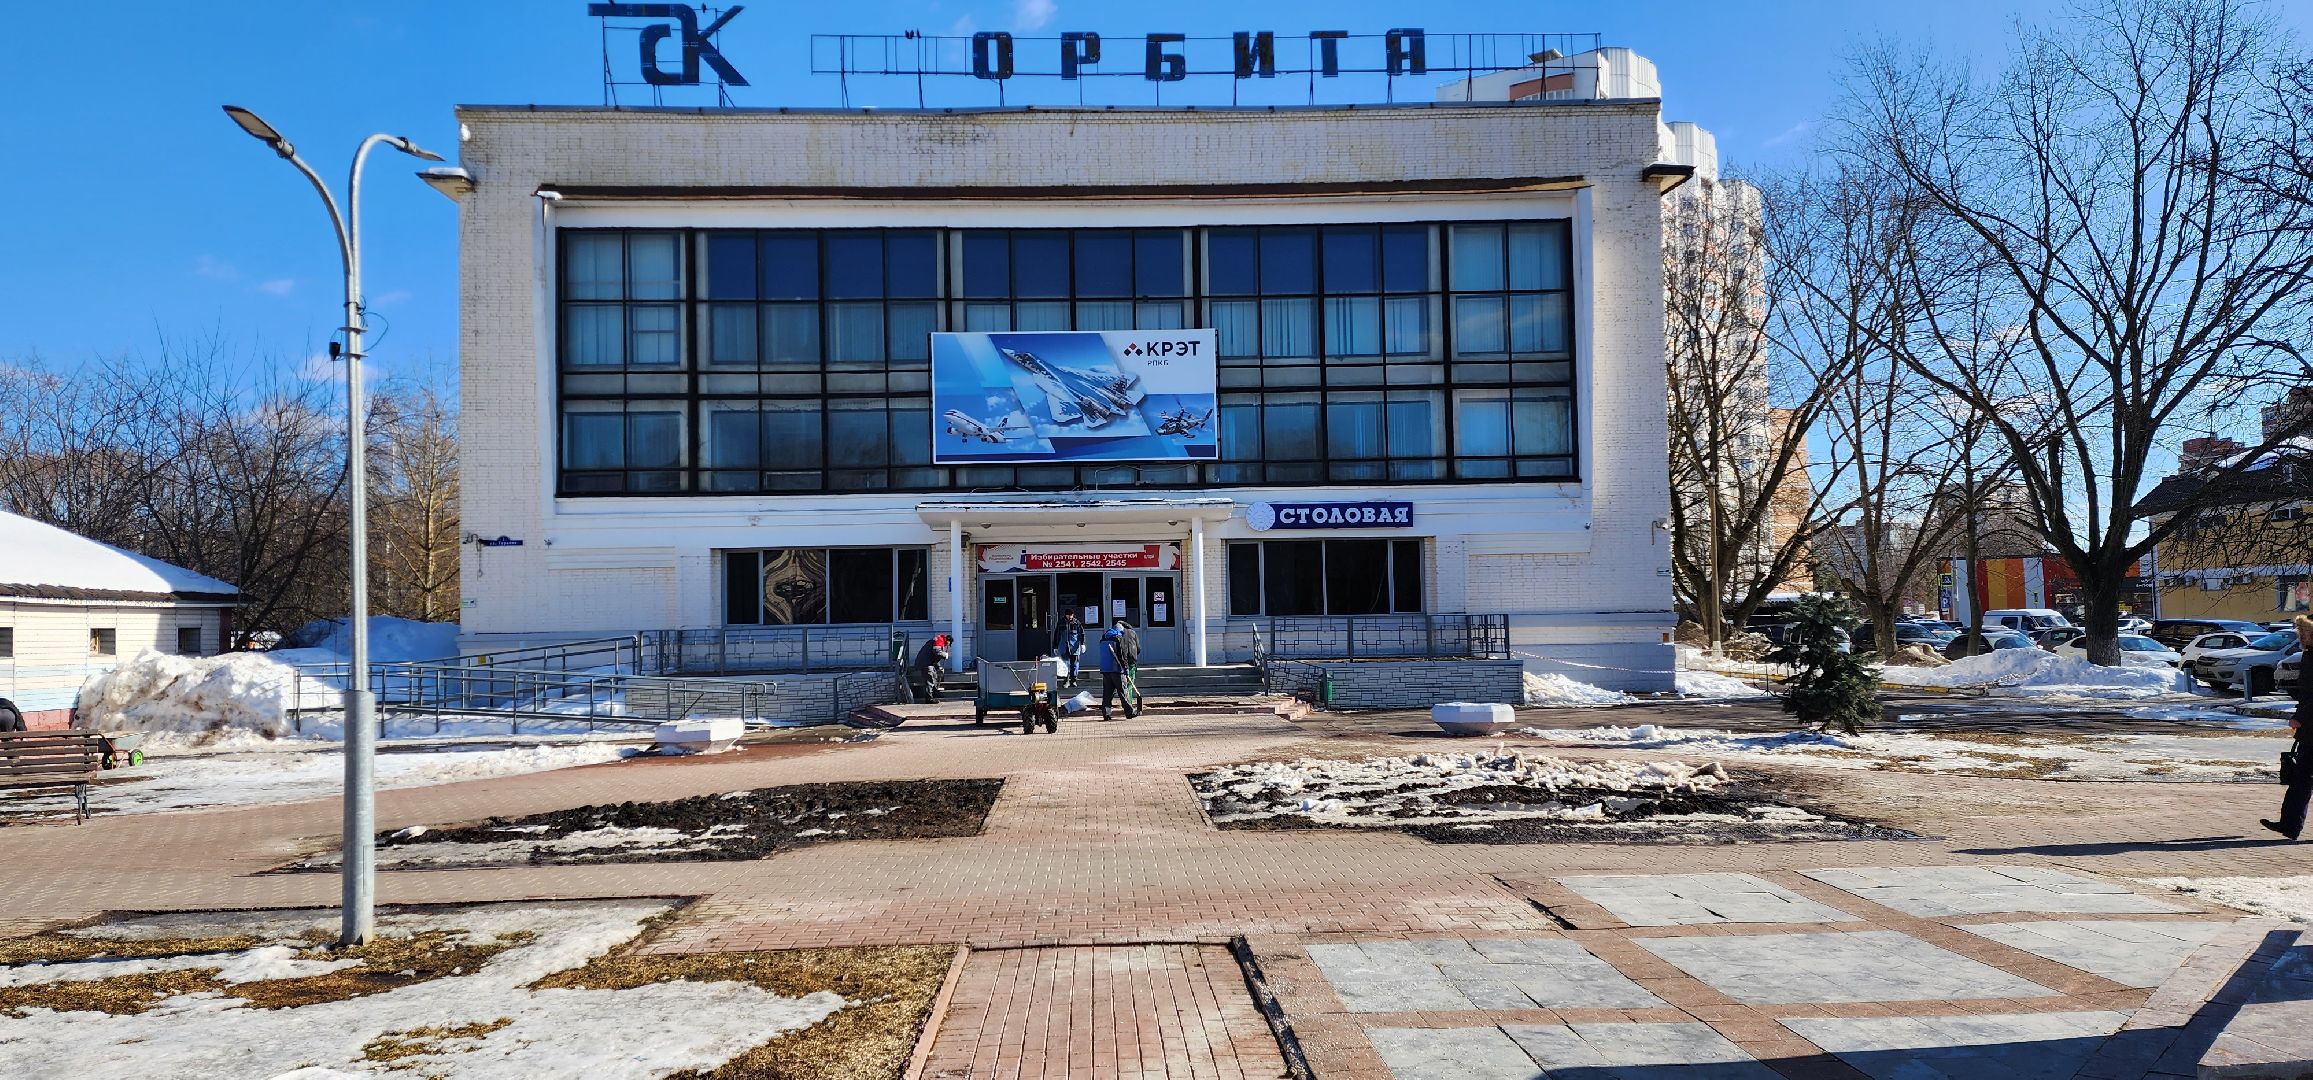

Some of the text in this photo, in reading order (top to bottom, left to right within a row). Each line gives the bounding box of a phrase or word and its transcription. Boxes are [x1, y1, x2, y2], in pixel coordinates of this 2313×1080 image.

[973, 28, 1426, 81] ОРБИТА
[1146, 341, 1201, 357] КРЭТ
[1279, 507, 1409, 524] СТОЛОВАЯ
[1031, 553, 1100, 561] Избирательные
[1103, 552, 1138, 560] участки
